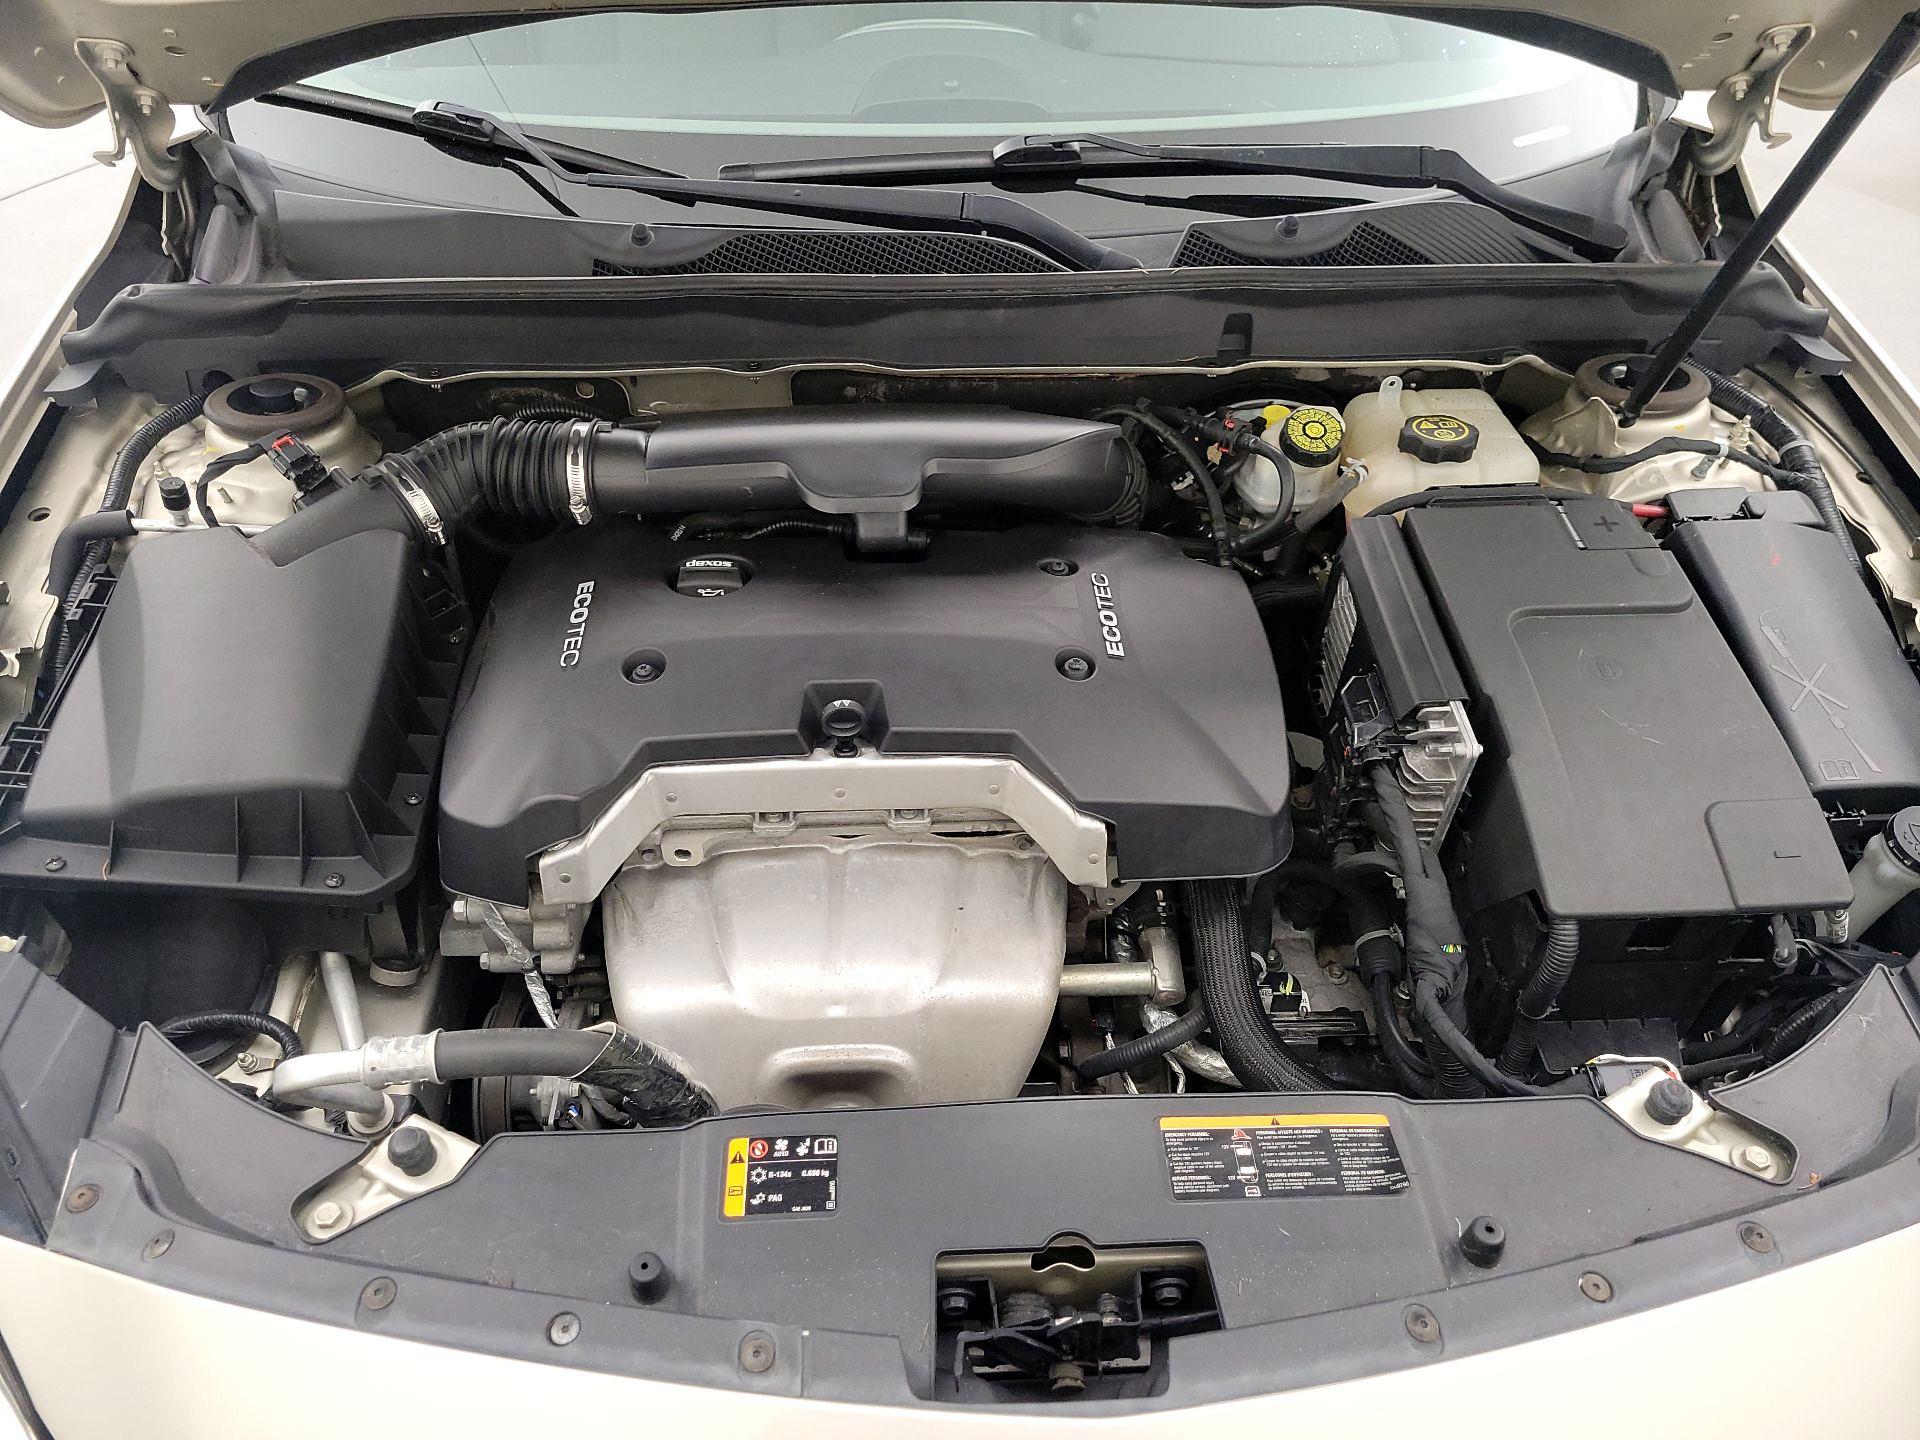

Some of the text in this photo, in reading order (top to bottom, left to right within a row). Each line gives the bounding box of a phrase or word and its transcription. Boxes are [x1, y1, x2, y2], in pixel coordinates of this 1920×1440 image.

[685, 559, 734, 568] dexos
[559, 580, 595, 668] ECOTEC
[1091, 572, 1126, 657] ECOTEC
[820, 1169, 830, 1177] kg
